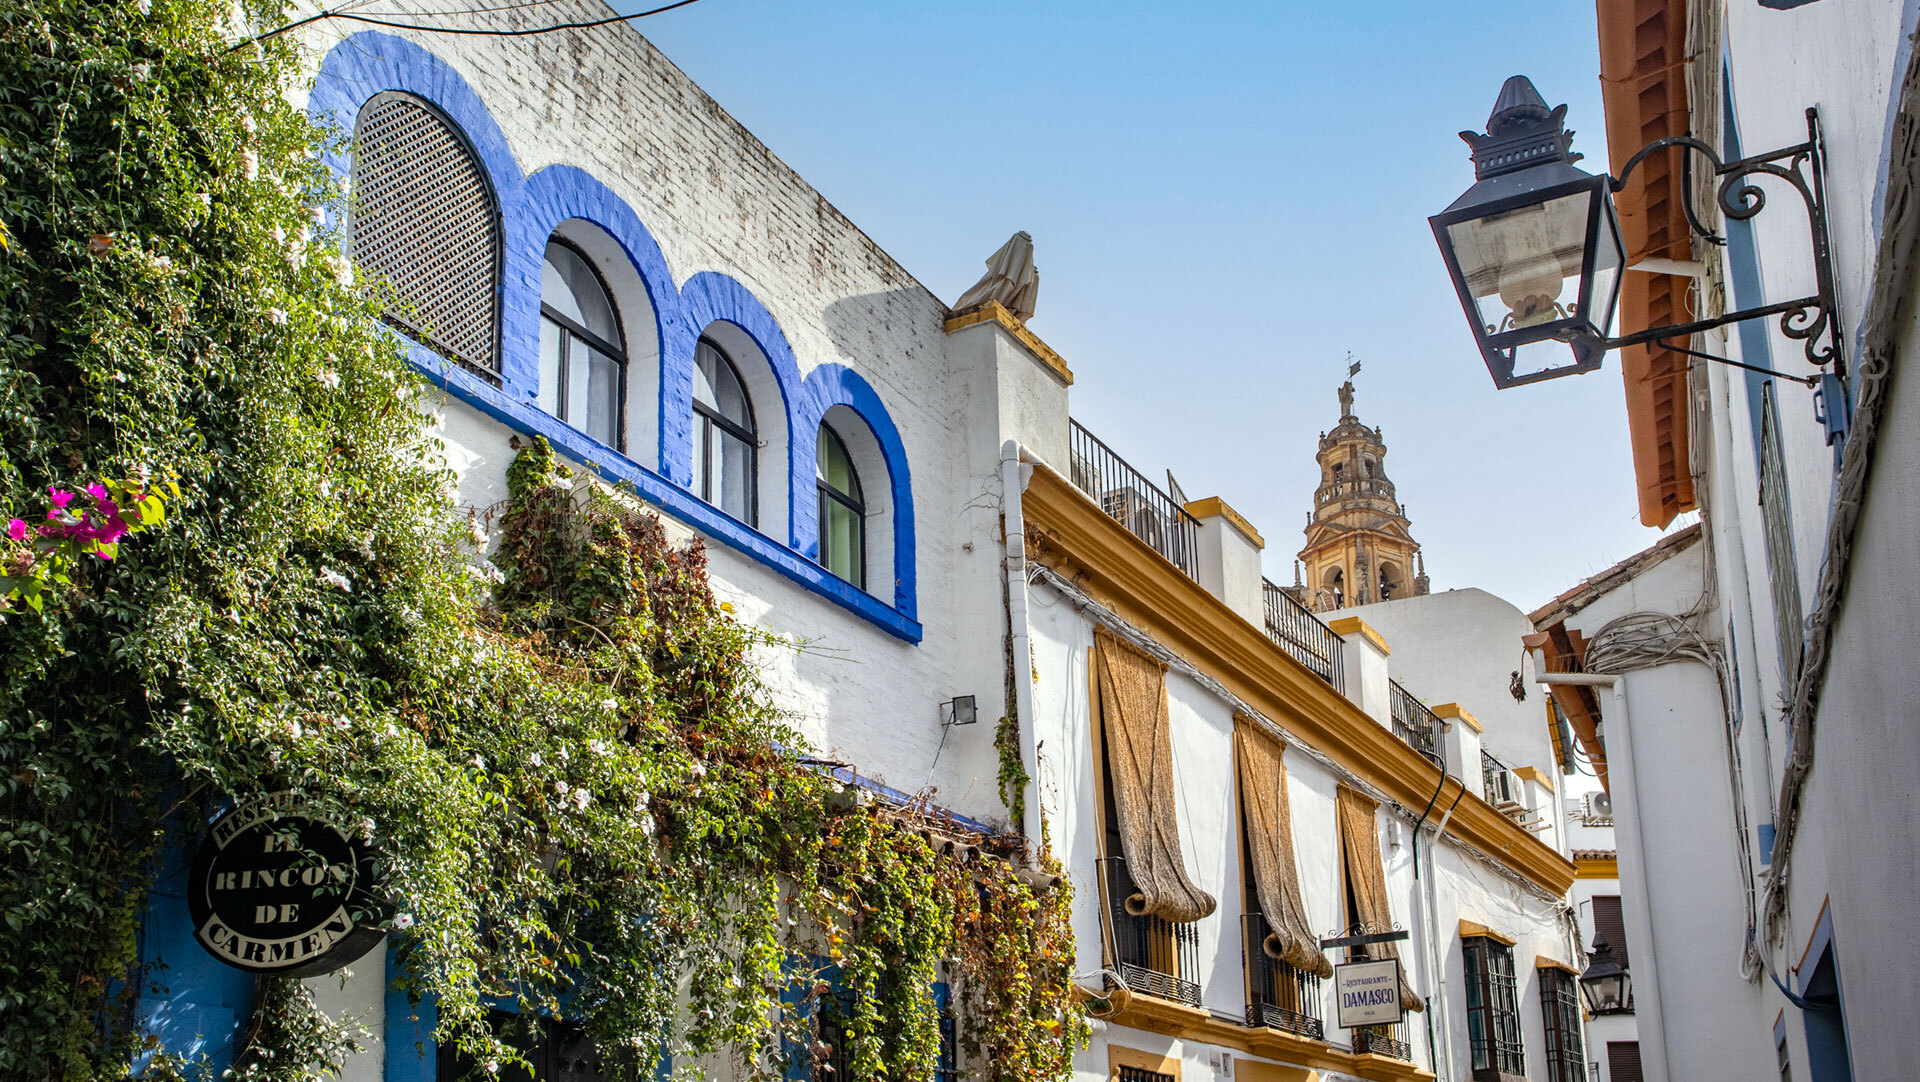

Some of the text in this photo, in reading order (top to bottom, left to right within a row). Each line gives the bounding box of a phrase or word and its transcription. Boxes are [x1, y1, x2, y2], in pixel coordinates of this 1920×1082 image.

[215, 865, 347, 890] RINCON
[253, 903, 300, 924] DE
[208, 913, 348, 963] CARMEN
[1343, 988, 1394, 1008] DAMASCO
